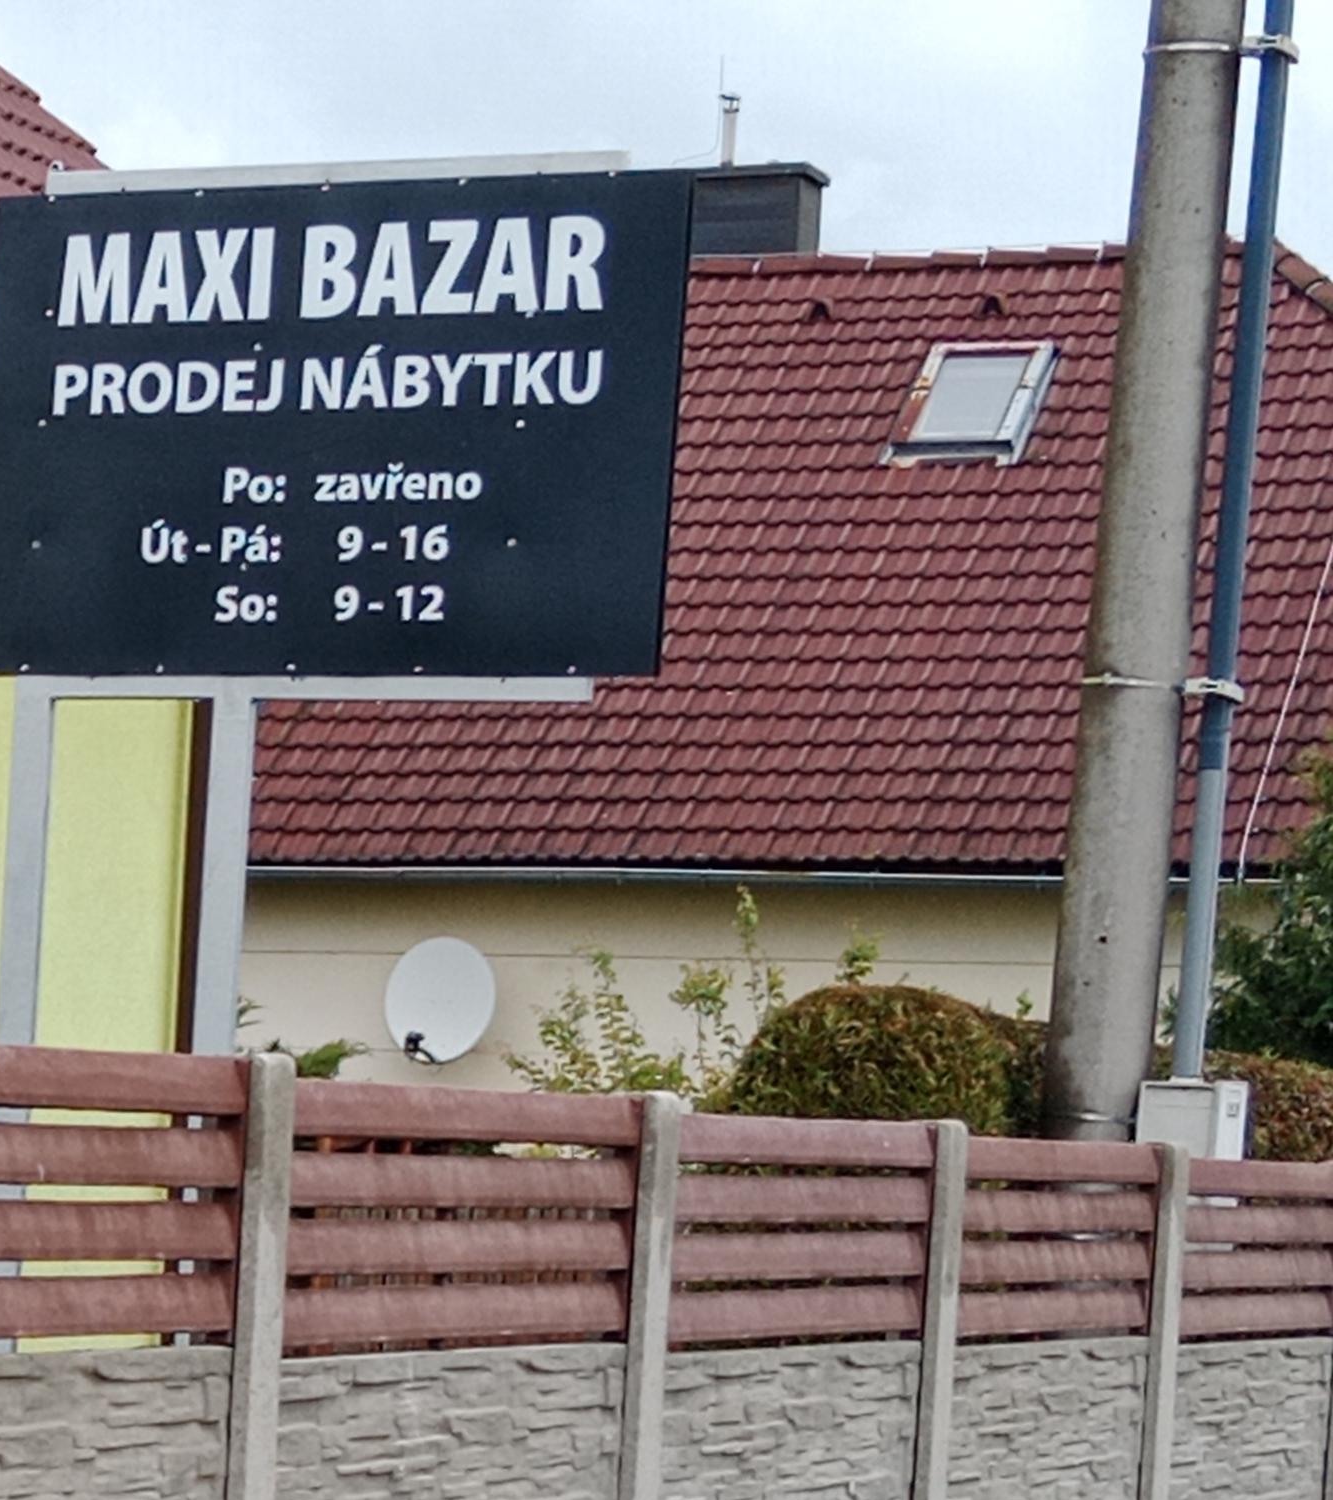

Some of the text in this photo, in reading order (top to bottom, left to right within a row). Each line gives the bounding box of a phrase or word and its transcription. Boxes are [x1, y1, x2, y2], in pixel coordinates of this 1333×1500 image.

[58, 214, 606, 327] MAXI BAZAR
[52, 343, 604, 416] PRODEJ NÁBYTKU
[222, 461, 483, 504] Po: zavřeno
[337, 525, 364, 562] 9
[400, 524, 450, 561] 16
[214, 585, 279, 623] So:
[334, 585, 360, 622] 9
[395, 585, 445, 621] 12
